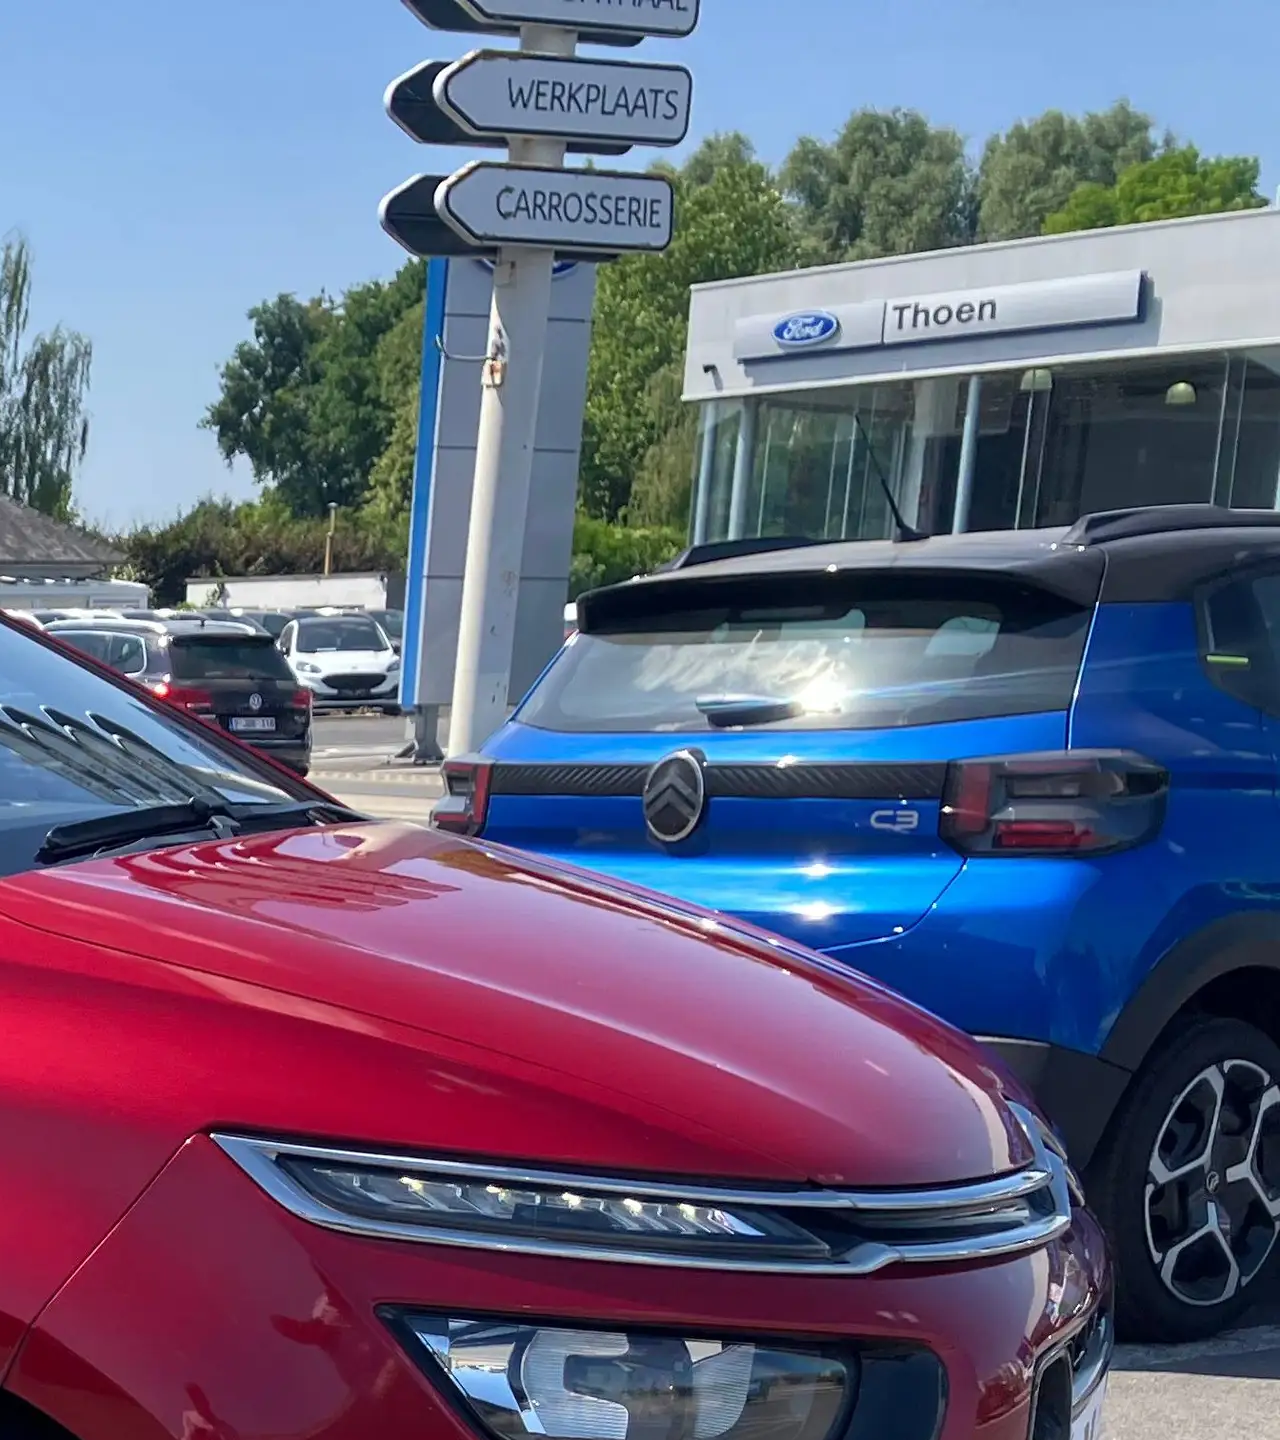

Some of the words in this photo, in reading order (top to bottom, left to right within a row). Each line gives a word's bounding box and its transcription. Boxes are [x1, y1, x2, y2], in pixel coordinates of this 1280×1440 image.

[508, 78, 679, 120] WERKPLAATS
[496, 186, 662, 228] CARROSSERIE
[782, 315, 825, 341] Ford
[893, 299, 997, 331] Thoen
[870, 810, 919, 829] C3
